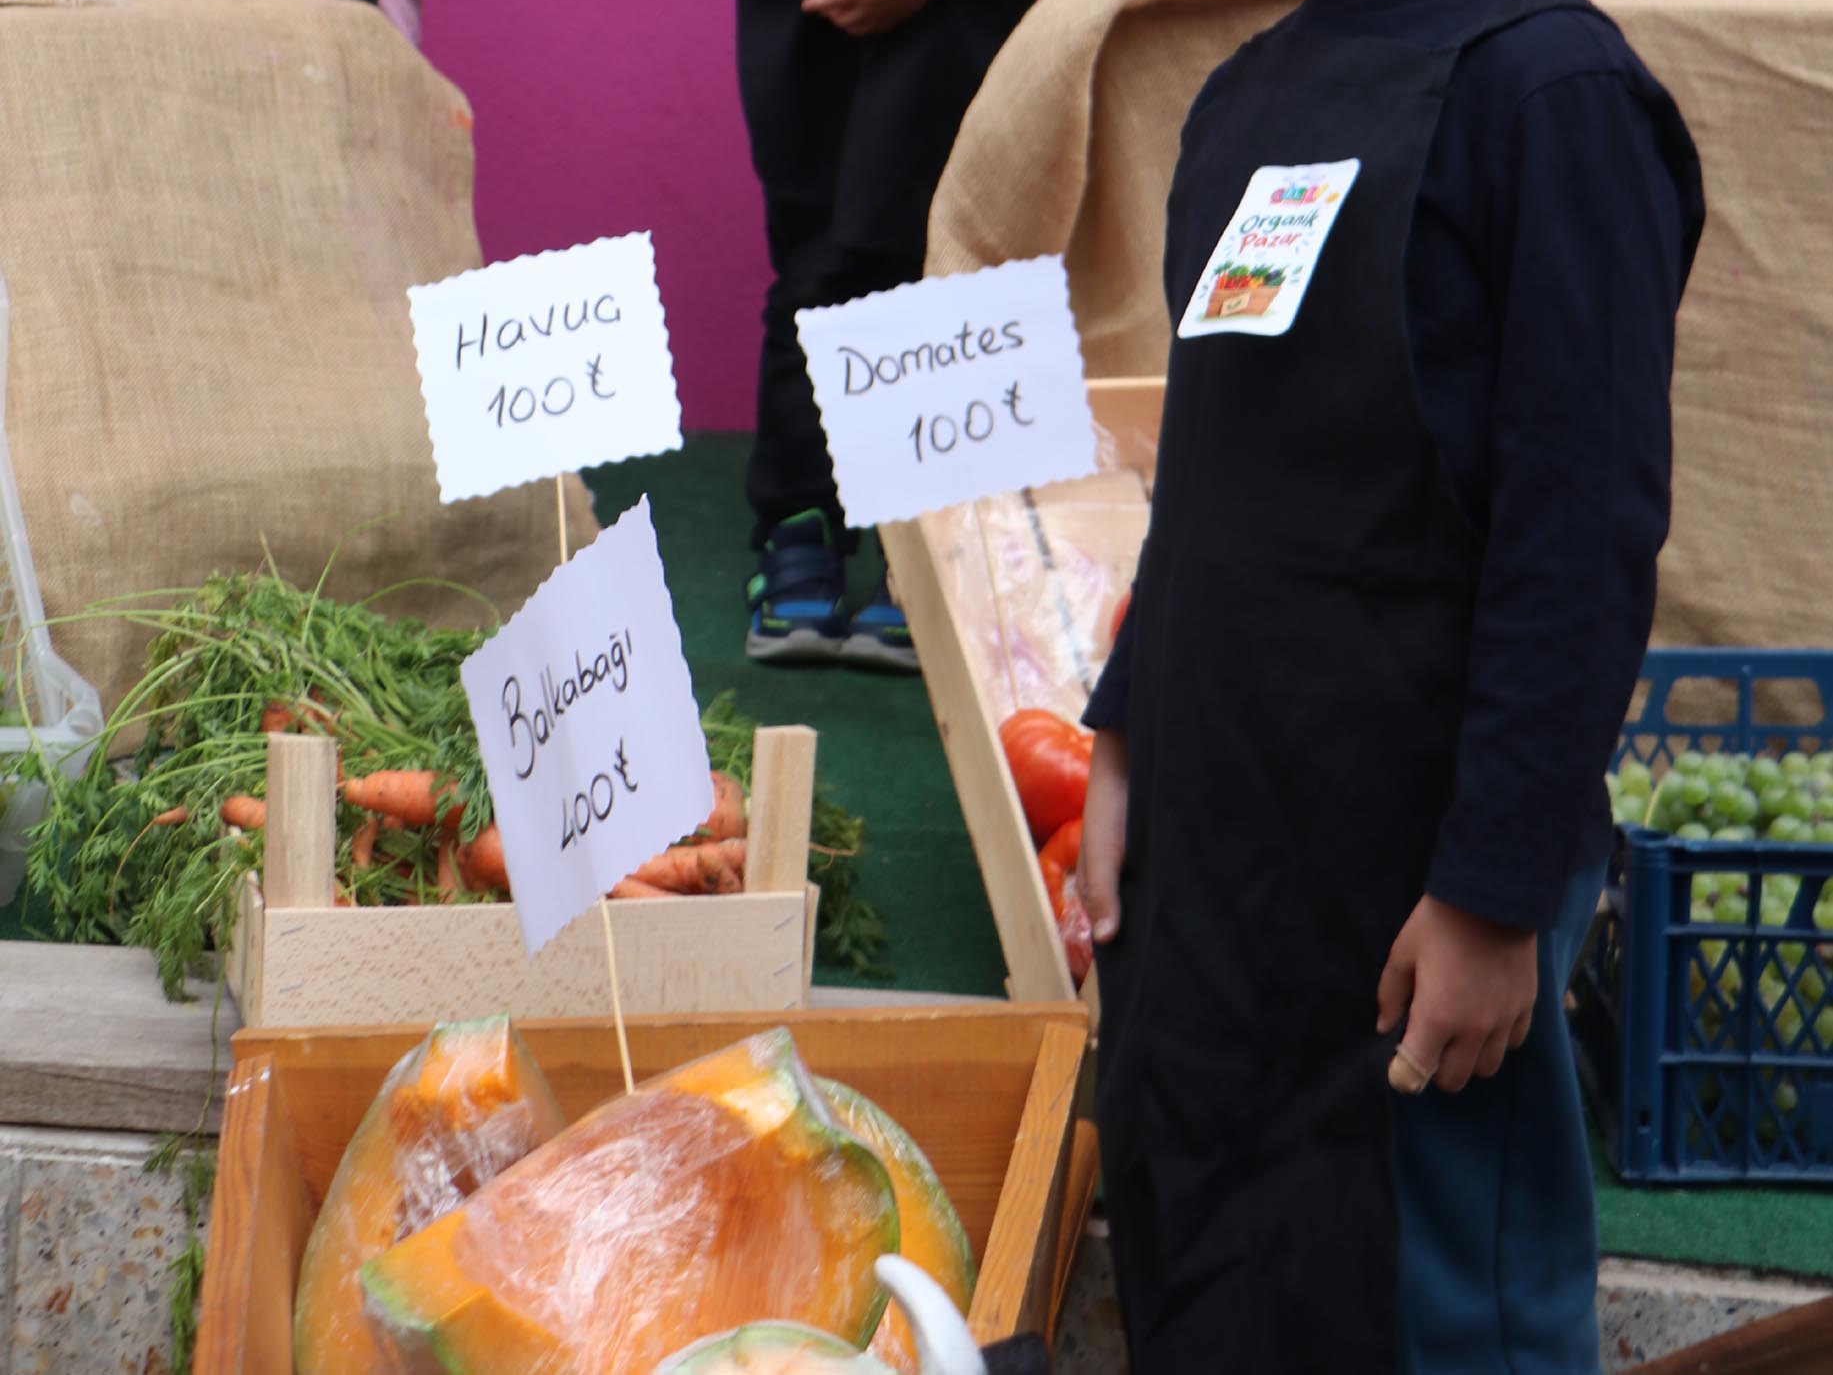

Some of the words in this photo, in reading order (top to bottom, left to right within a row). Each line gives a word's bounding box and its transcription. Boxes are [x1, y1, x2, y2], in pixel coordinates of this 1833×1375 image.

[1238, 231, 1303, 256] Pazar
[1239, 208, 1320, 234] Organik
[836, 320, 1024, 396] Domates
[501, 626, 633, 781] Balkabağı
